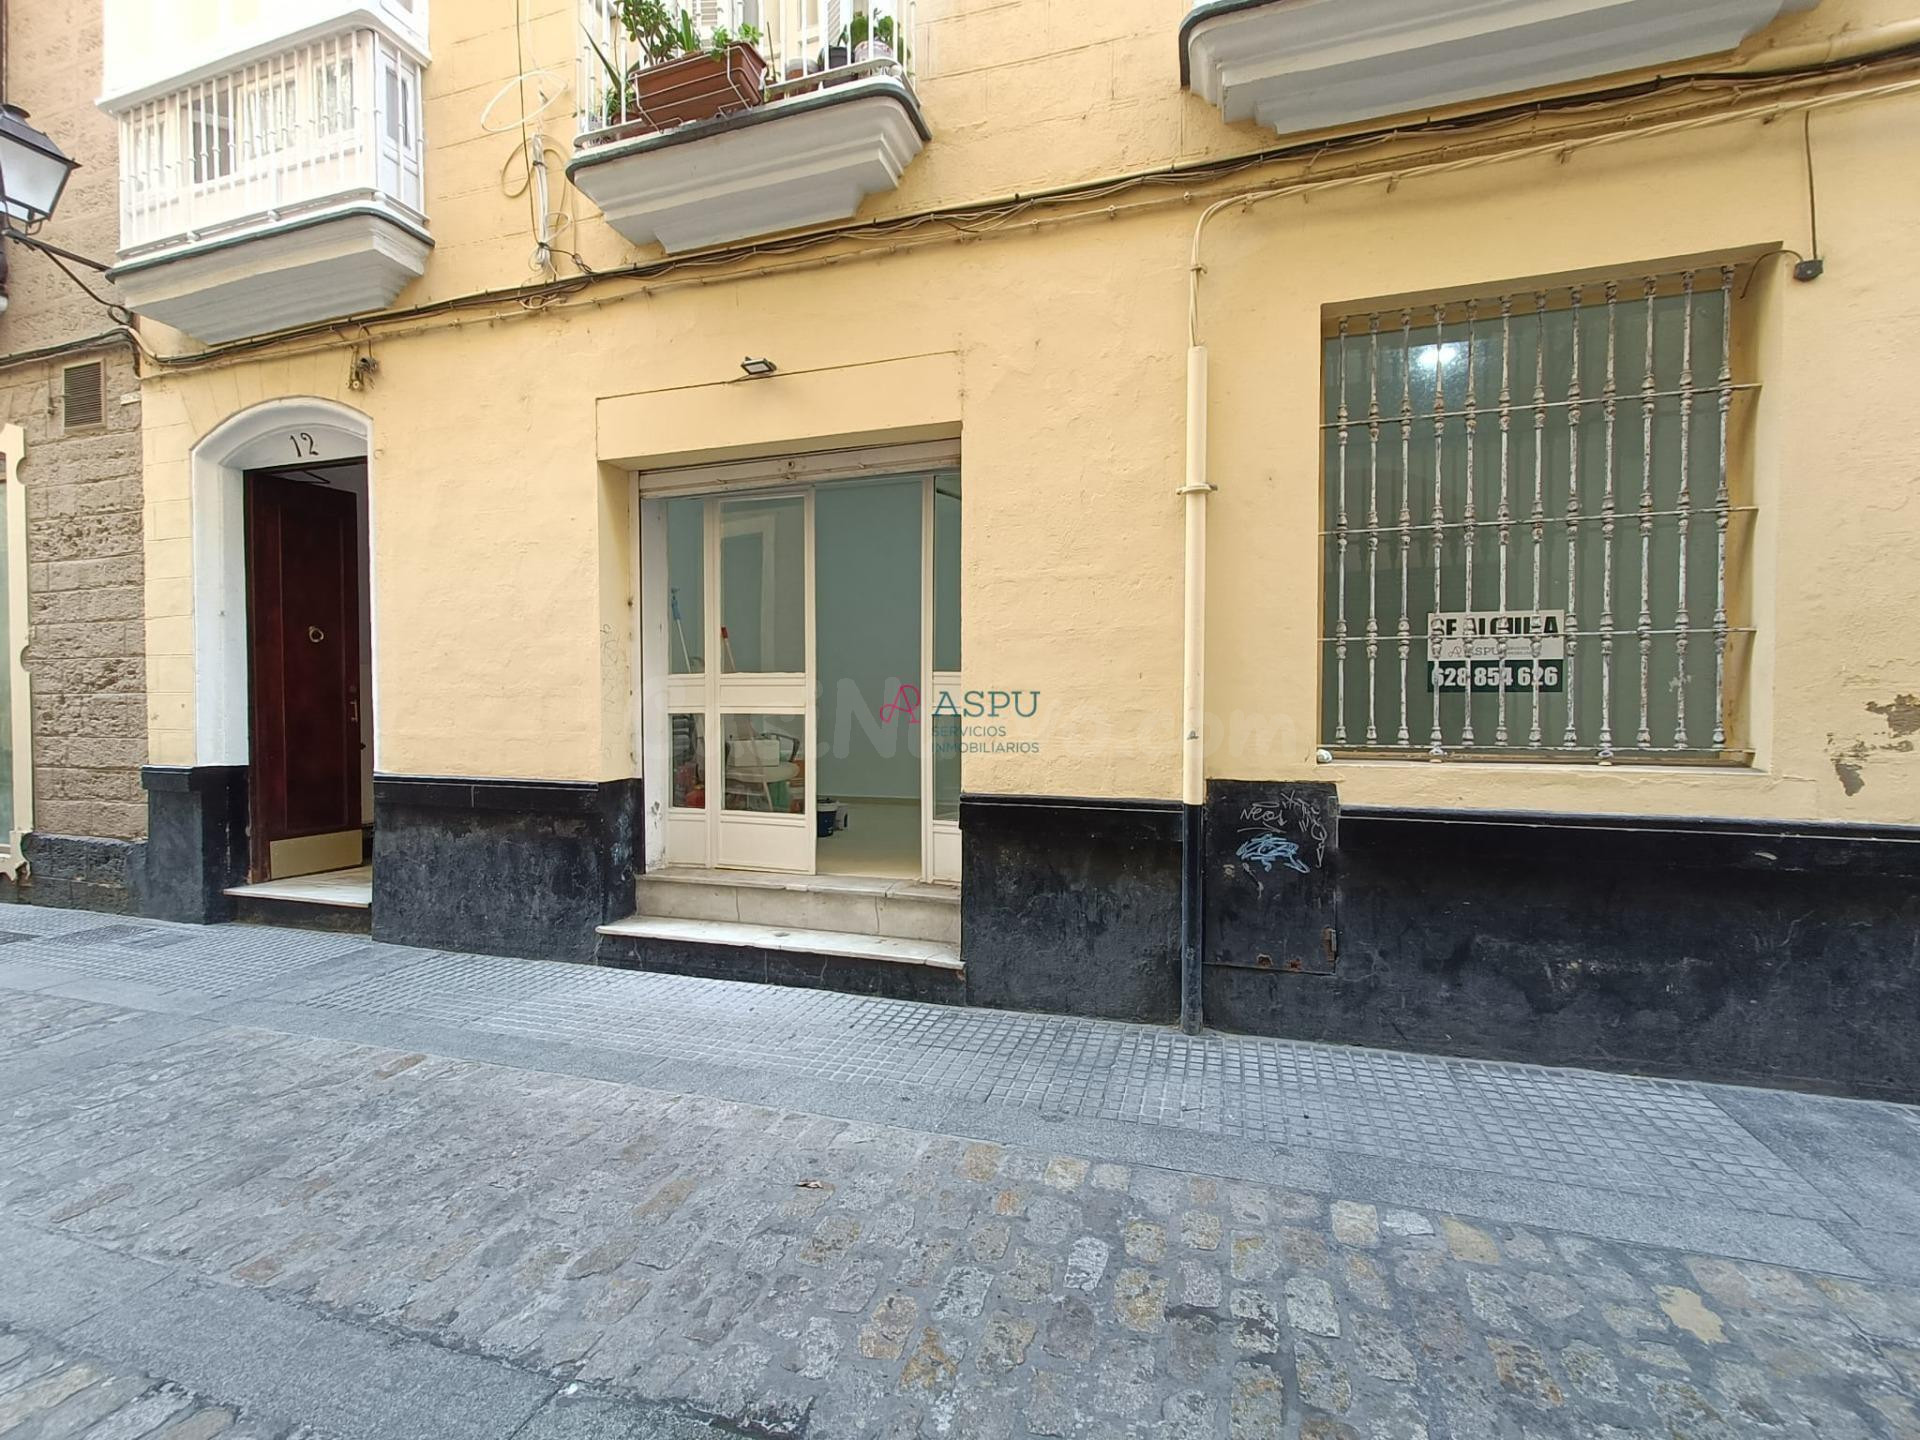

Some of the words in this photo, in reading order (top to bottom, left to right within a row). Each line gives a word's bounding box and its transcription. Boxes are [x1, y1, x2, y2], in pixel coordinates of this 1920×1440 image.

[290, 432, 319, 457] 12
[1431, 667, 1469, 686] 628
[1474, 667, 1513, 686] 854
[1518, 666, 1558, 685] 626
